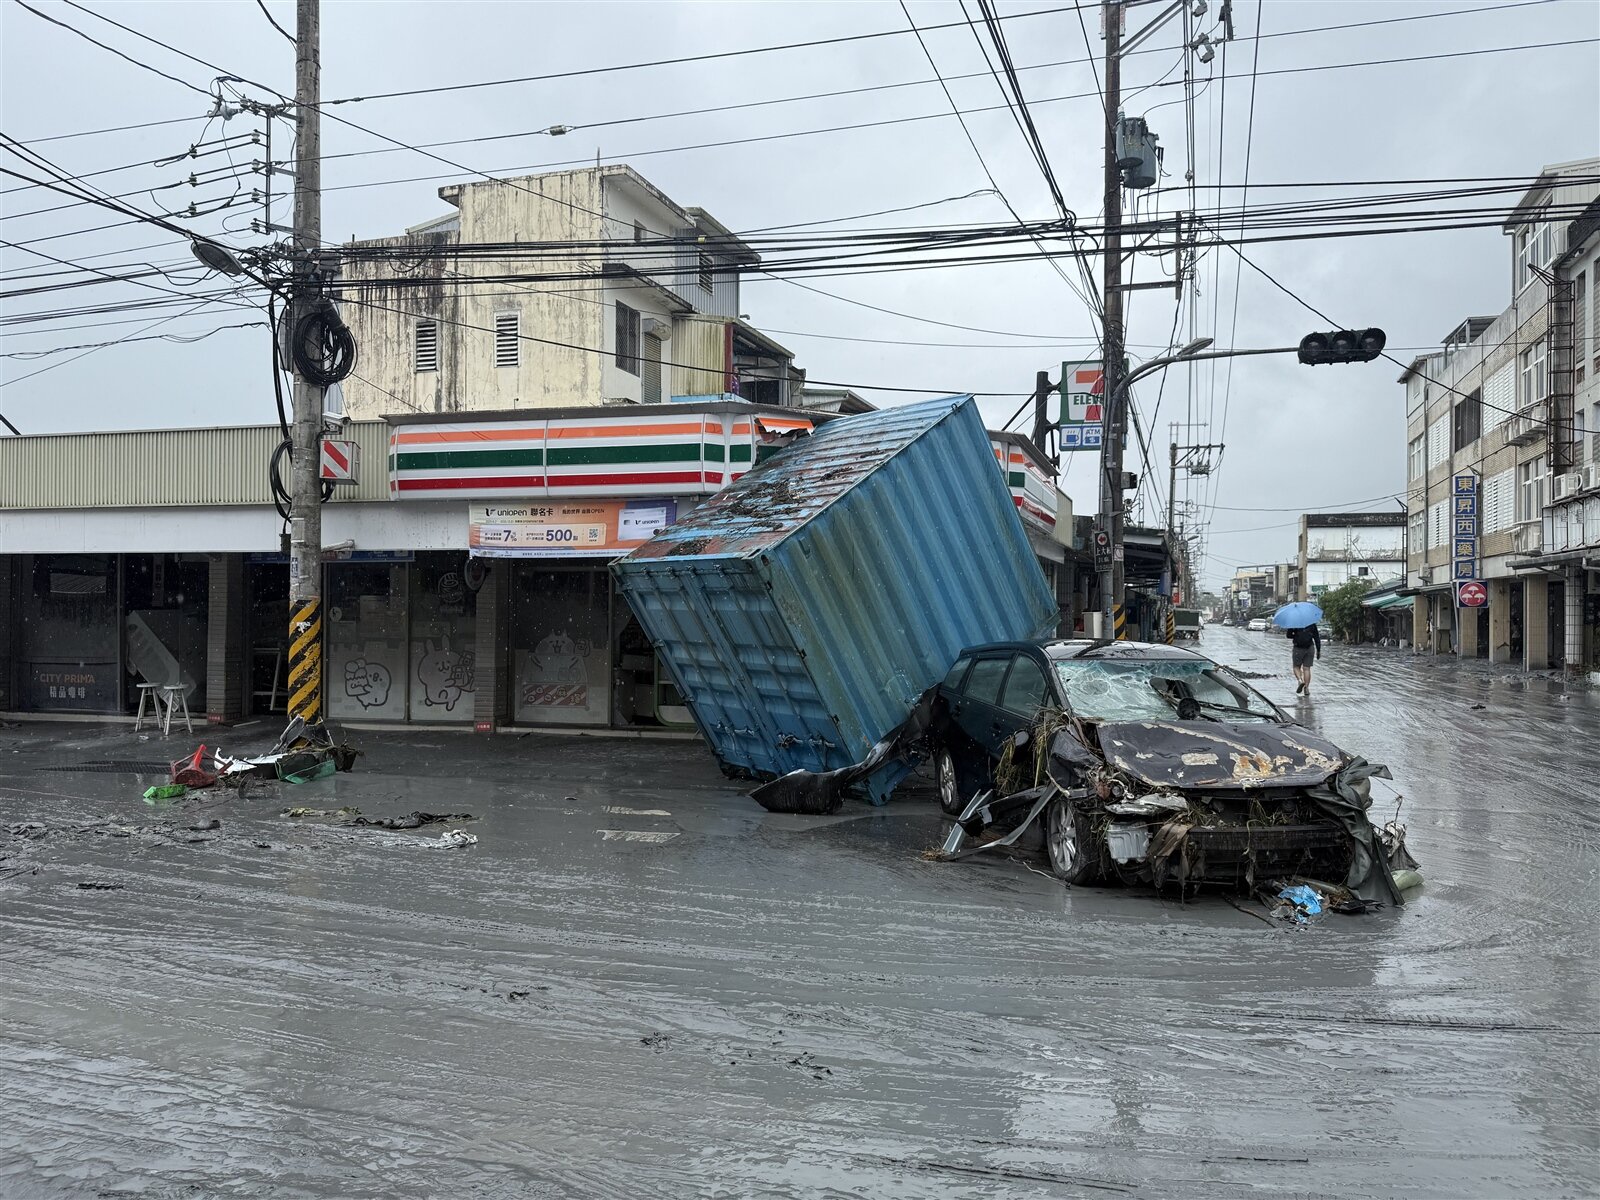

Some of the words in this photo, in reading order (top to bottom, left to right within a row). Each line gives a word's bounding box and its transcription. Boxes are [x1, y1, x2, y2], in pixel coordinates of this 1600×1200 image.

[530, 507, 554, 517] 聯名卡
[1457, 477, 1473, 577] 東昇西藥房
[40, 673, 61, 683] CITY
[64, 674, 96, 684] PRIMA
[50, 685, 85, 699] 精品咖啡
